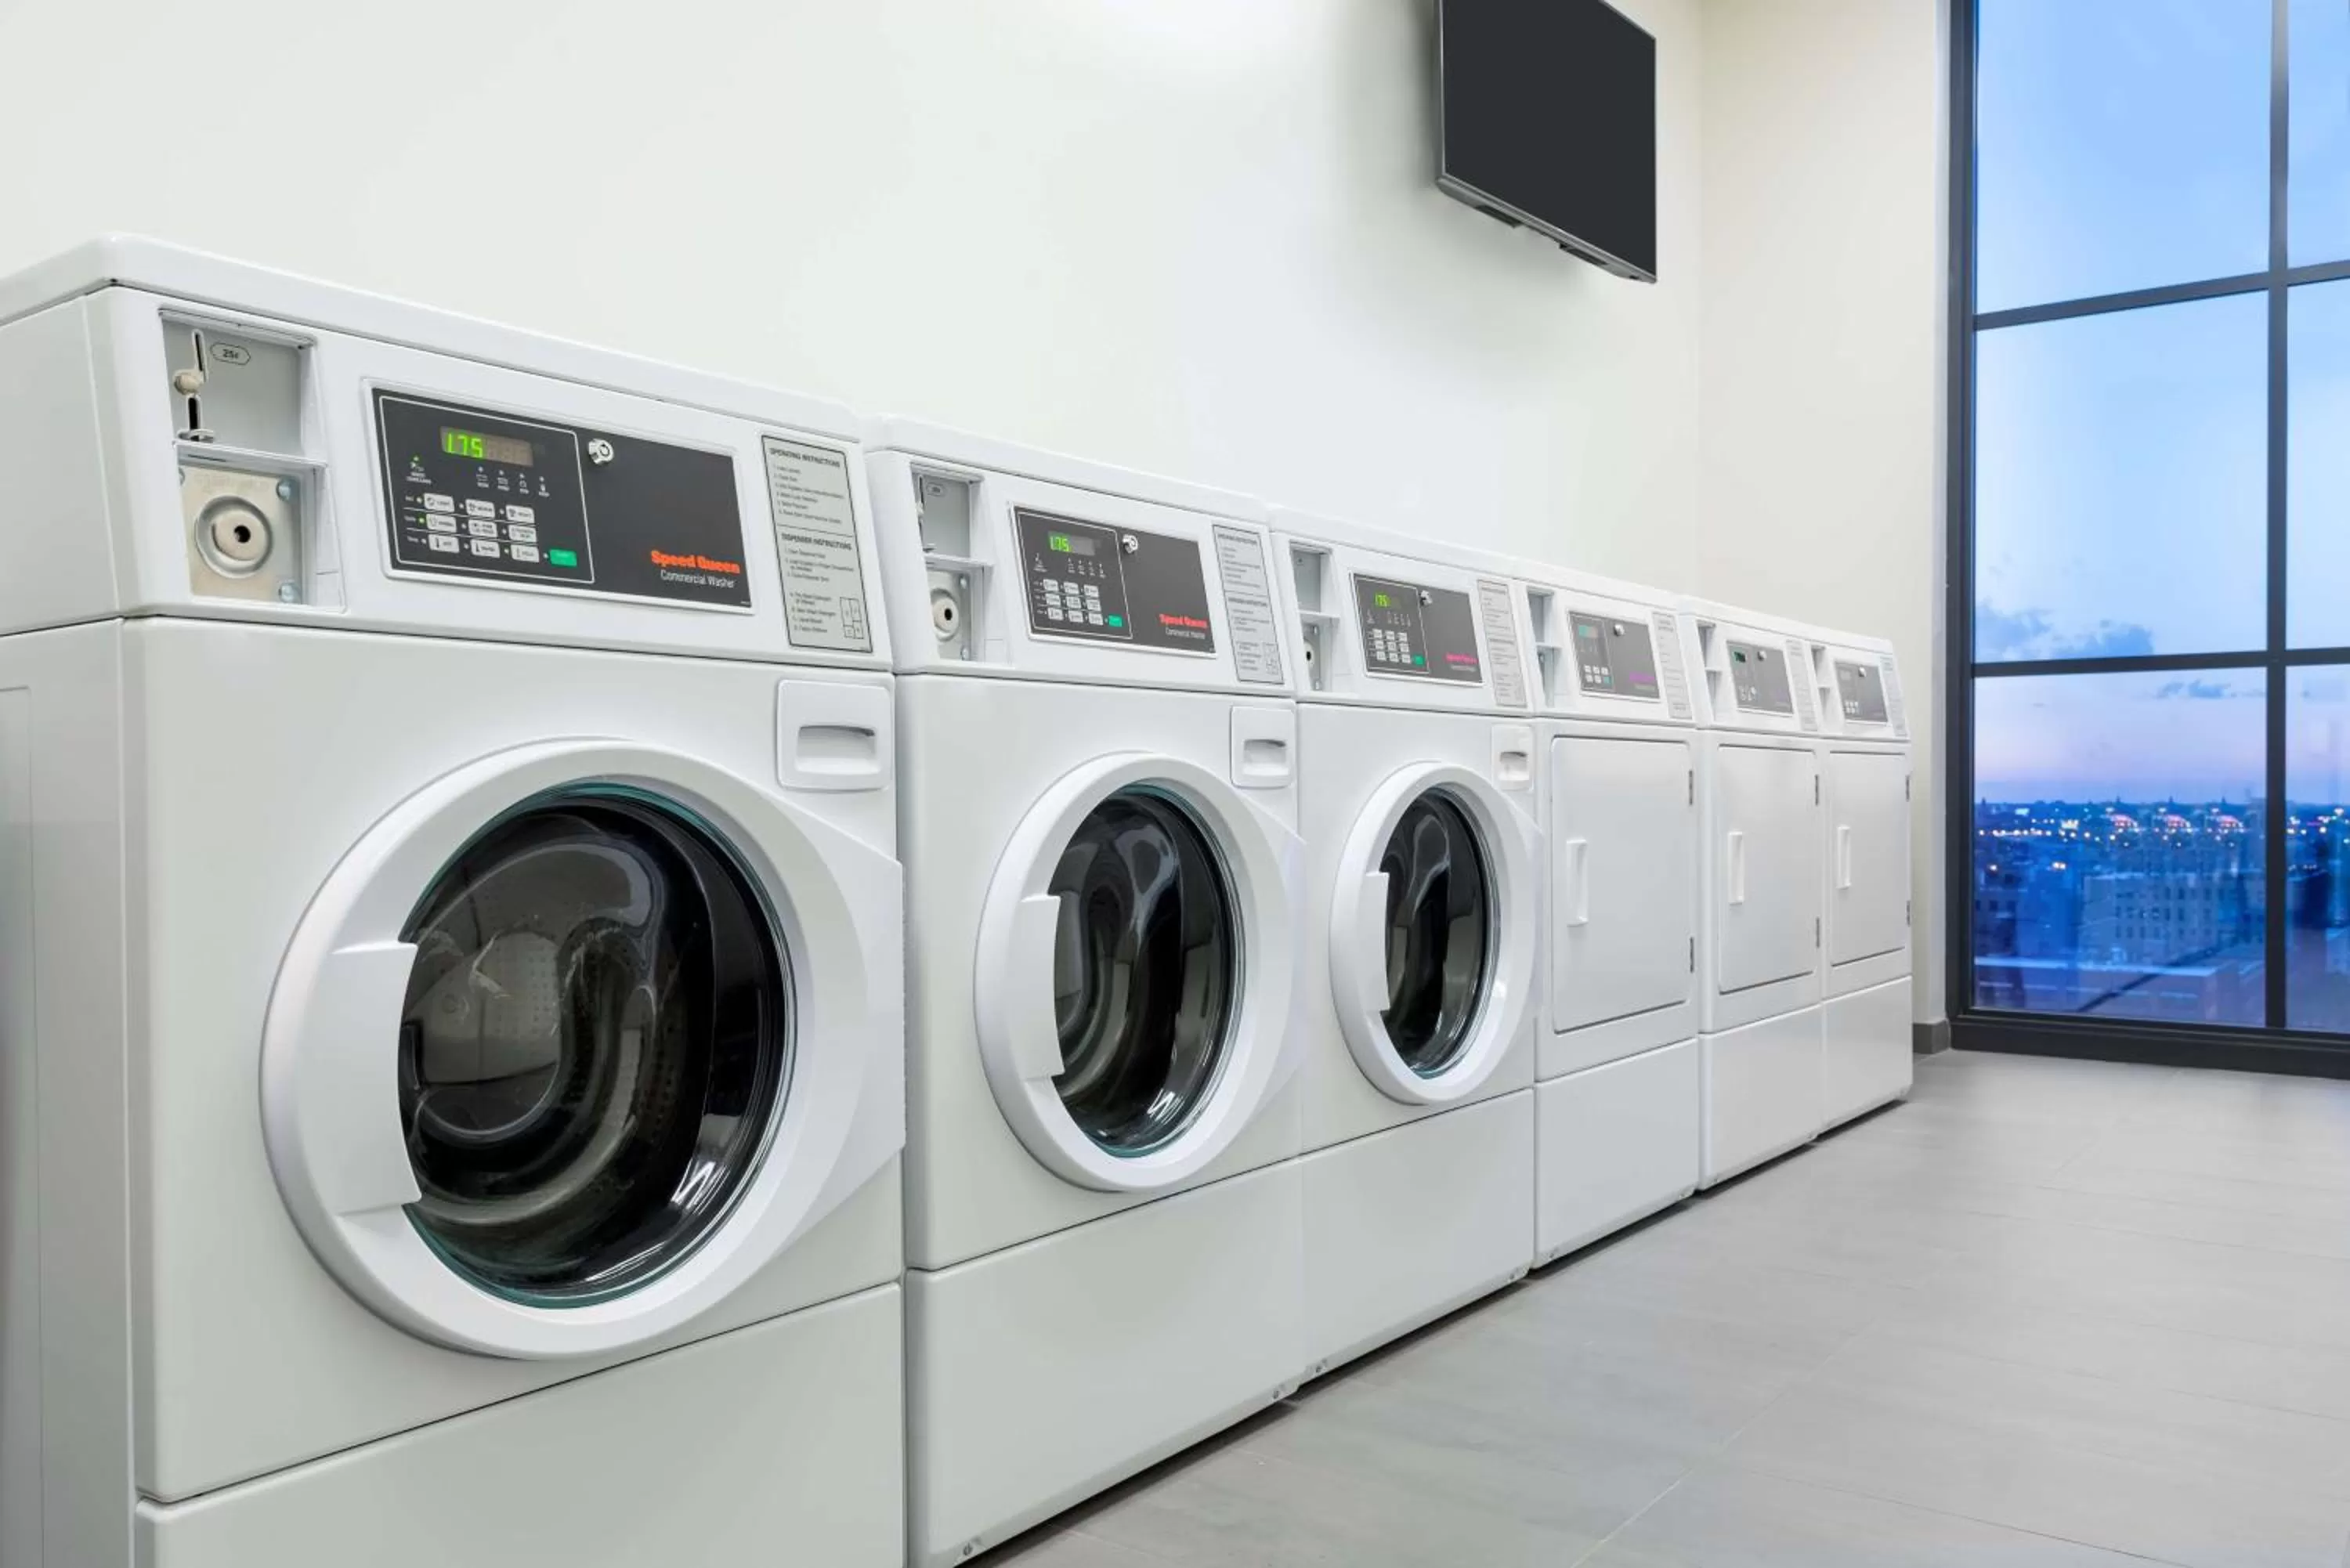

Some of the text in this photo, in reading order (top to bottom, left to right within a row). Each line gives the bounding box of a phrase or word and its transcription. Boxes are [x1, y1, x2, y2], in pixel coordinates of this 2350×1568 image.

[651, 550, 740, 574] Speed Queen
[660, 569, 737, 589] Commercial Washer
